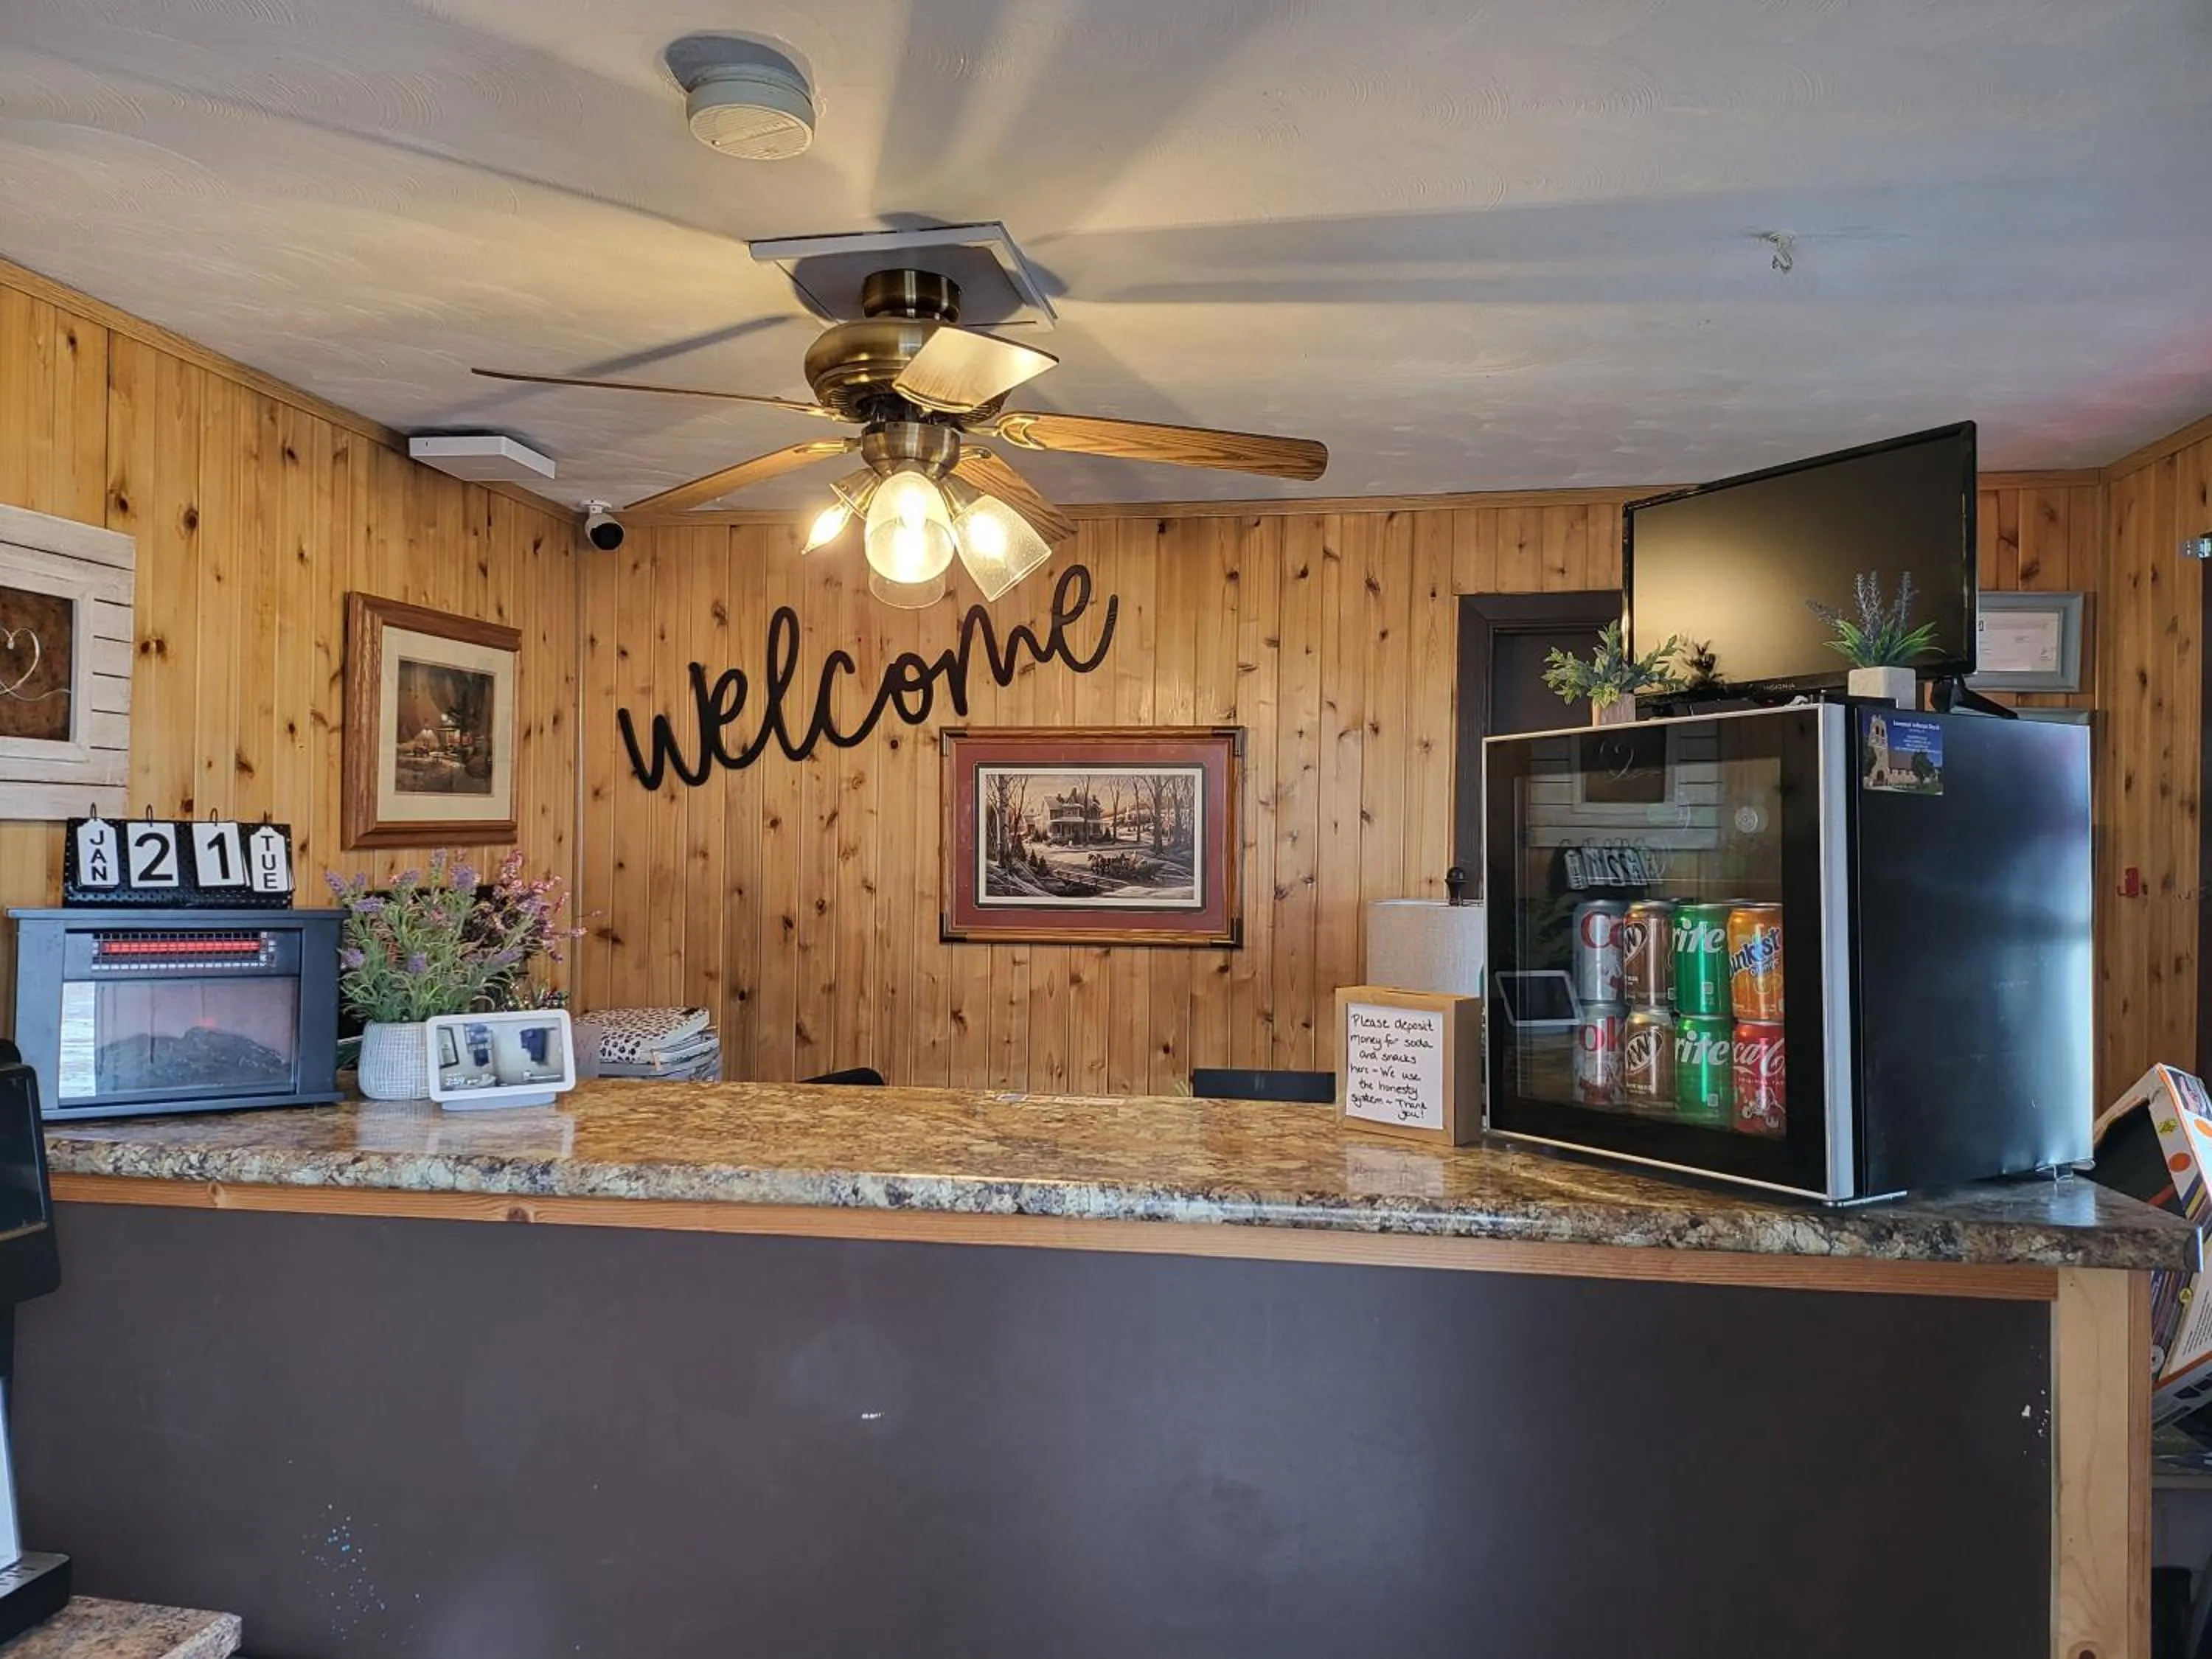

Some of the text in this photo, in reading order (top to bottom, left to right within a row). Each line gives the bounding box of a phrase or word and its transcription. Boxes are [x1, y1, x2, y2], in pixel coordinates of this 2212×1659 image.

[617, 564, 1119, 791] welcome
[89, 830, 108, 882] JAN
[260, 835, 278, 889] TUE
[1672, 917, 1726, 953] rite
[1351, 1014, 1434, 1033] Please deposit
[1404, 1039, 1433, 1048] soda
[1676, 1030, 1731, 1065] rite
[1381, 1054, 1416, 1064] snacks
[1402, 1072, 1421, 1081] use
[1359, 1077, 1418, 1101] the honesty
